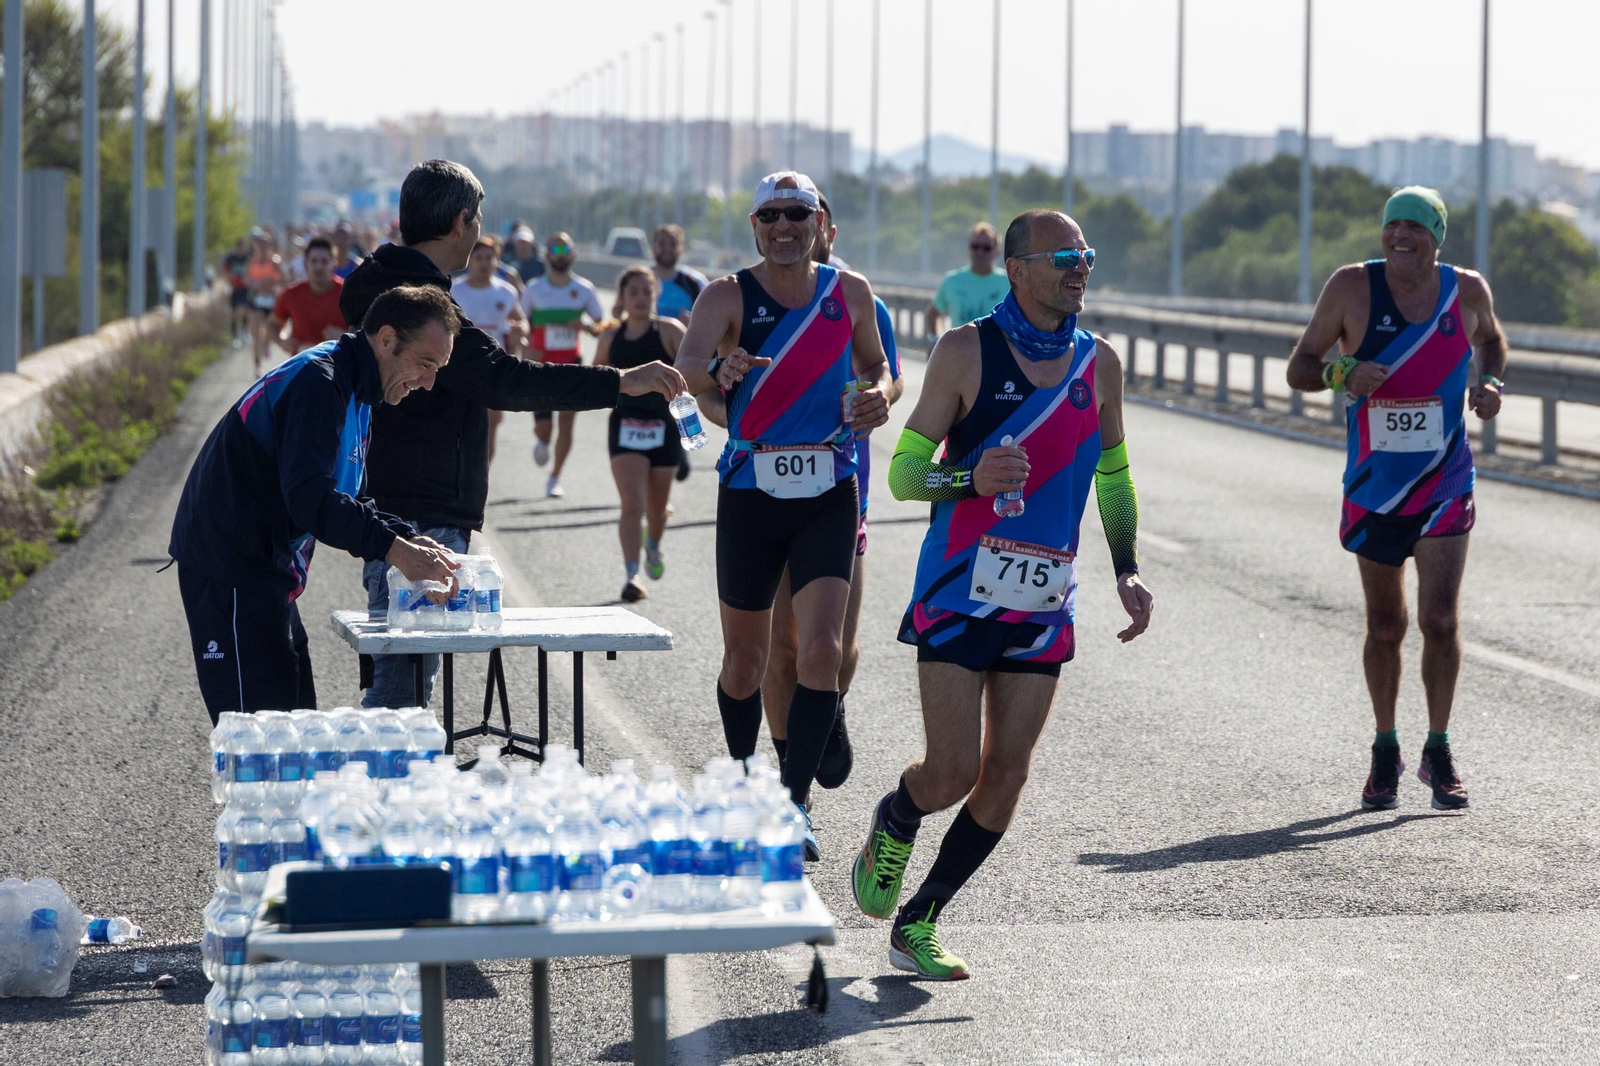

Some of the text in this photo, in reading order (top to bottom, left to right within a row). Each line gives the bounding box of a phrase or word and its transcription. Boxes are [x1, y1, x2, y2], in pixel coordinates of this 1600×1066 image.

[1386, 412, 1427, 432] 592
[774, 455, 816, 476] 601
[982, 536, 1016, 550] XXXVI
[1016, 547, 1037, 555] BAHÍA
[998, 556, 1050, 588] 715
